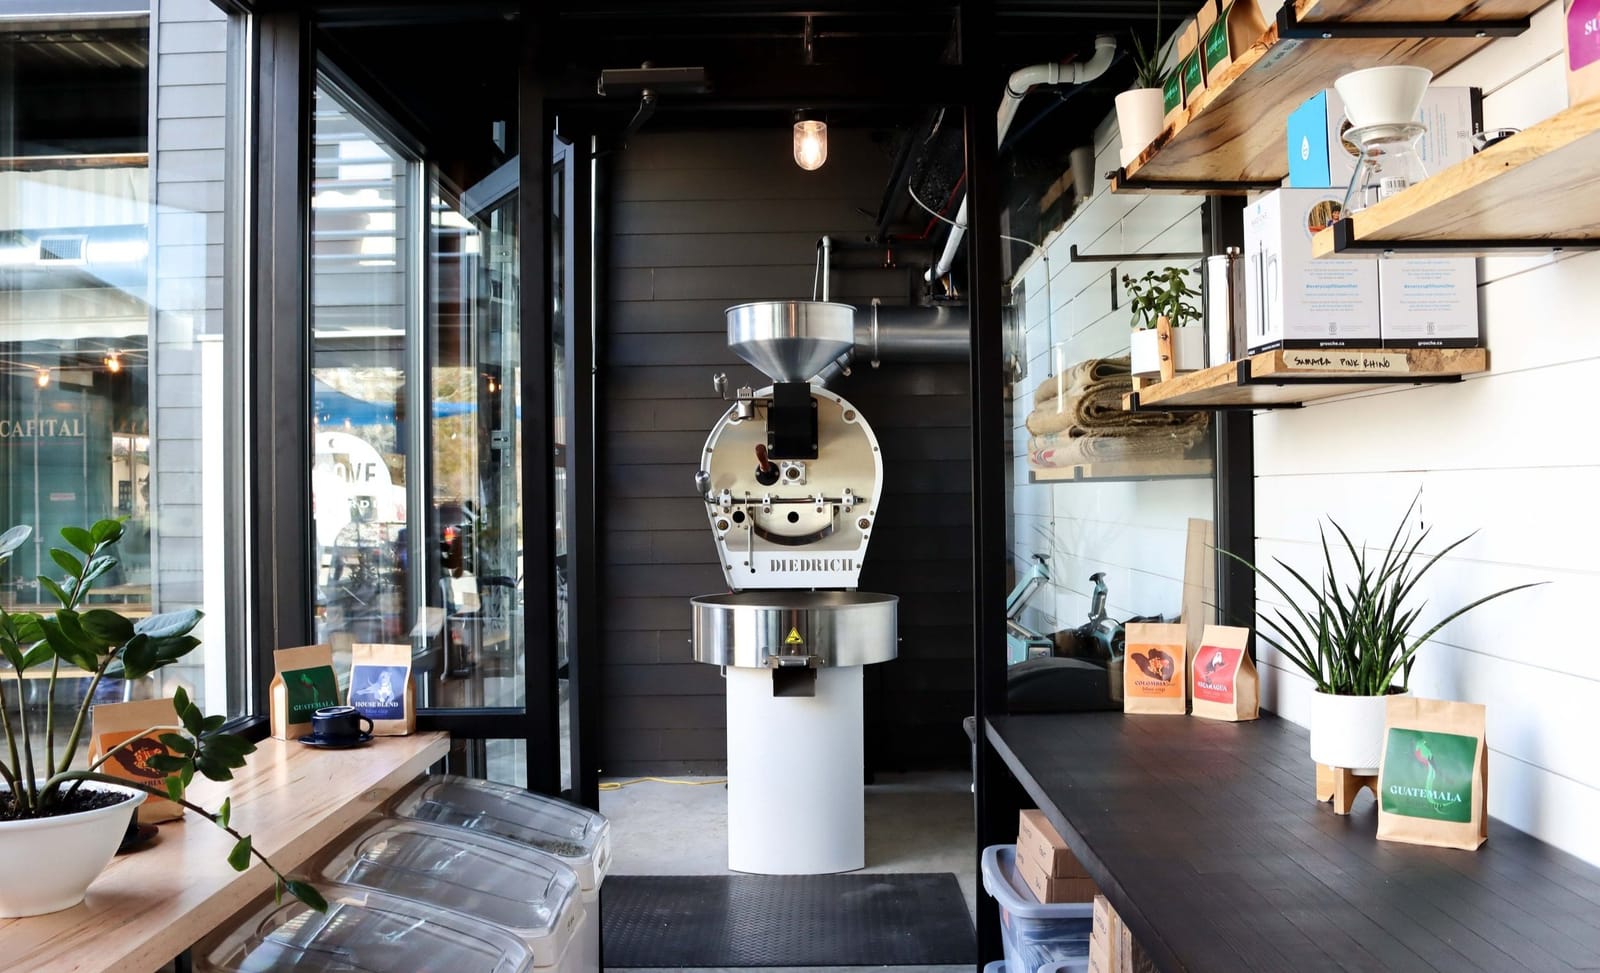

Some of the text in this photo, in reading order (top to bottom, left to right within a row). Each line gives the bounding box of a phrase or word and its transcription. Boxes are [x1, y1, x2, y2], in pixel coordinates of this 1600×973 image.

[1340, 358, 1360, 367] PINK
[1363, 357, 1391, 369] RHINO
[770, 558, 854, 572] DIEDRICH
[293, 700, 335, 711] GUATEMALA
[1390, 785, 1462, 802] GUATEMALA
